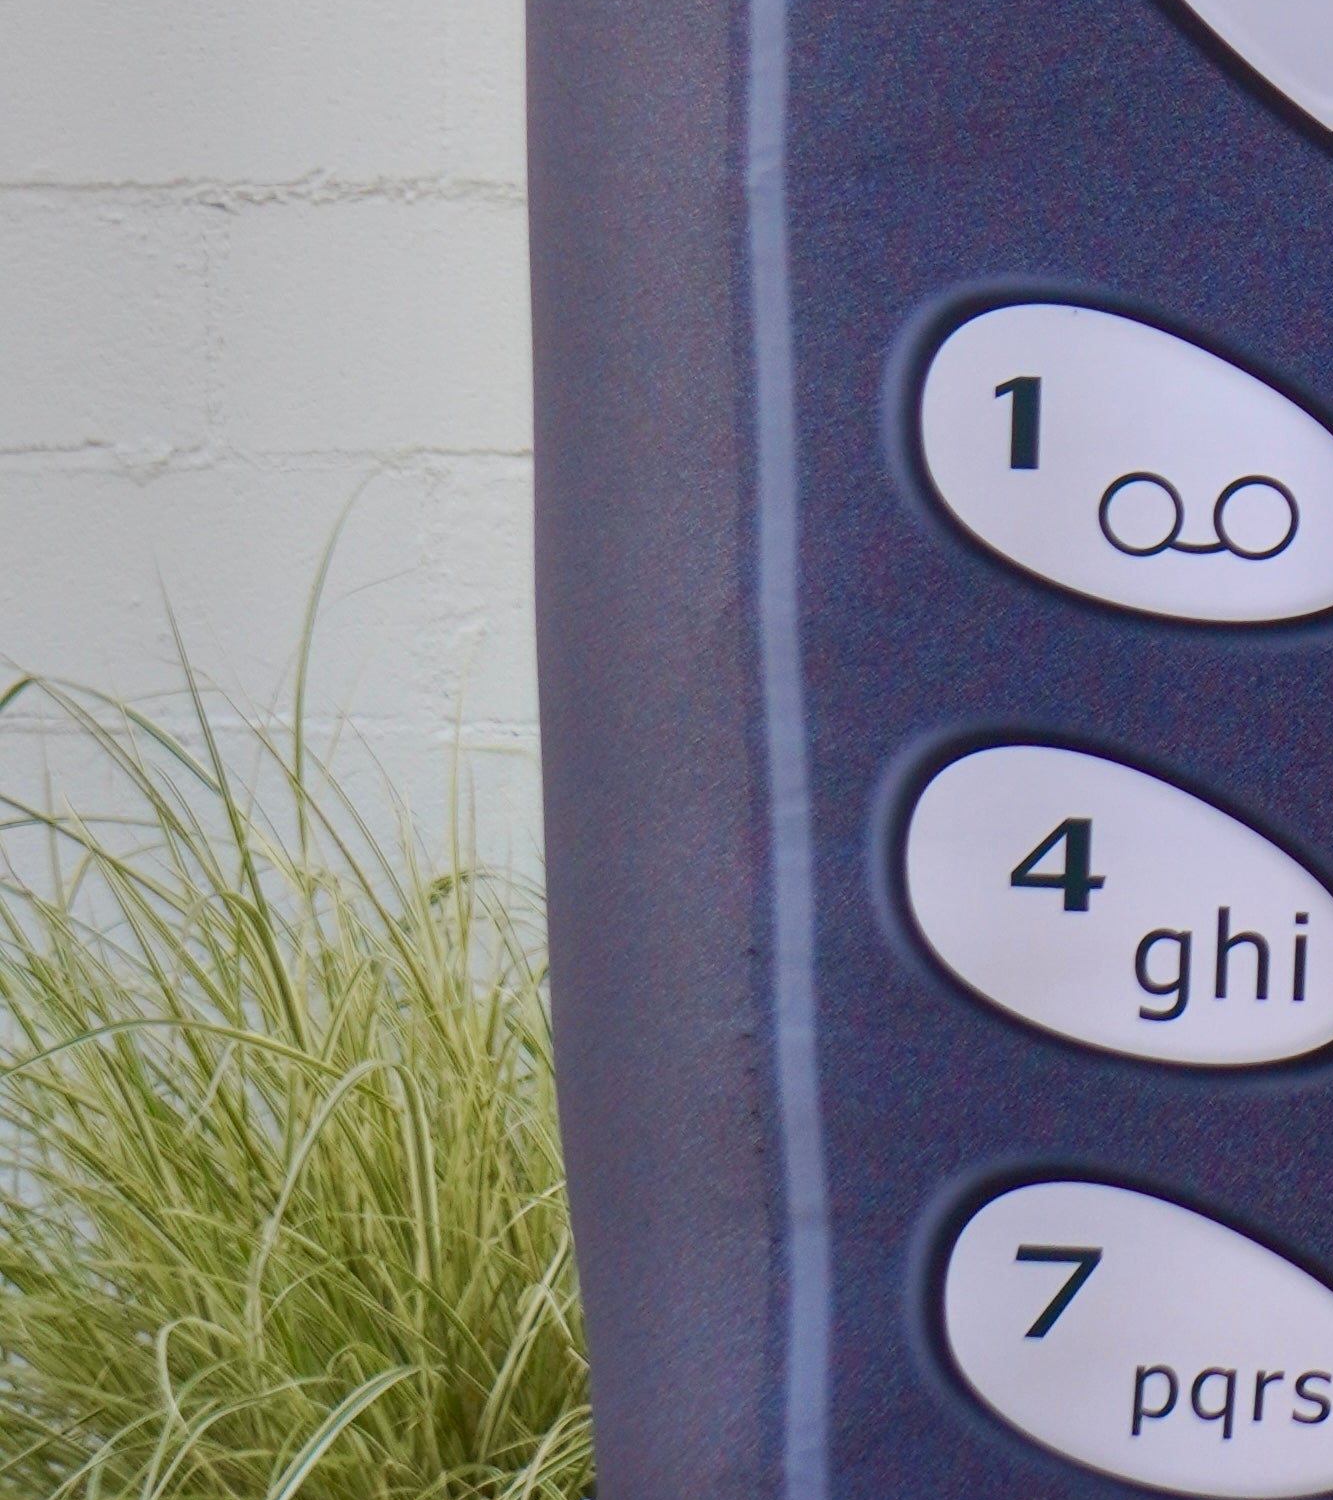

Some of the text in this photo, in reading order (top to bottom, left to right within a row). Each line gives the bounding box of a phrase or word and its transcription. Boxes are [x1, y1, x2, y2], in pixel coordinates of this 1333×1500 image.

[994, 376, 1043, 470] 1
[1010, 817, 1106, 913] 4
[1134, 906, 1309, 1022] ghi
[1015, 1244, 1104, 1339] 7
[1131, 1363, 1333, 1440] pqrs
